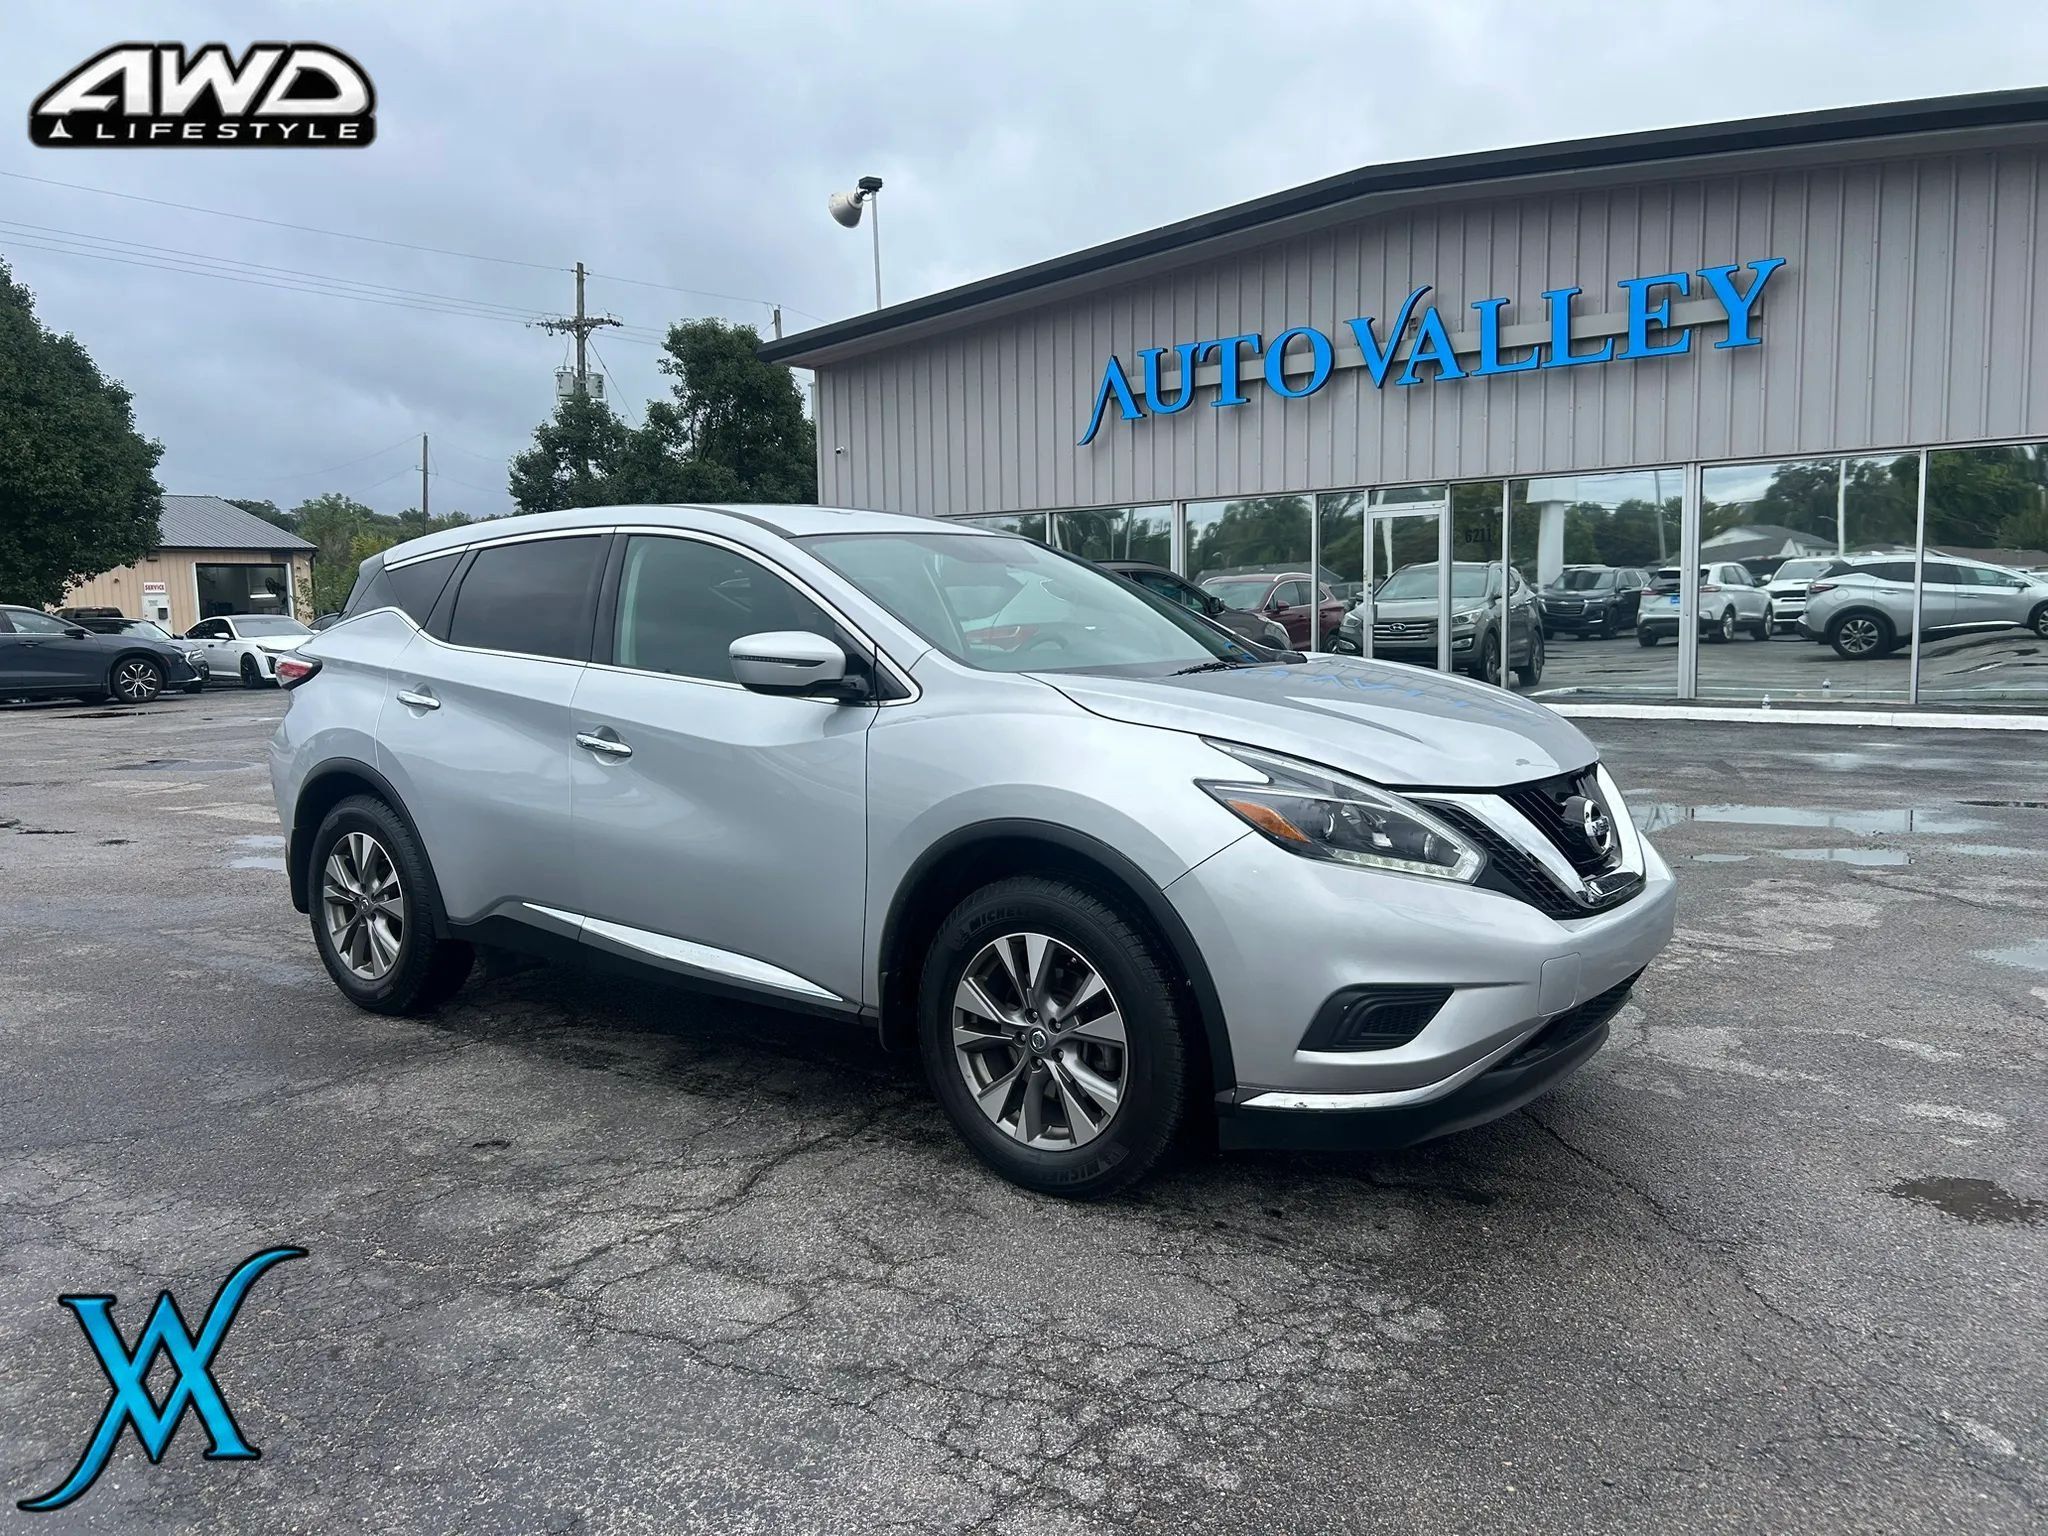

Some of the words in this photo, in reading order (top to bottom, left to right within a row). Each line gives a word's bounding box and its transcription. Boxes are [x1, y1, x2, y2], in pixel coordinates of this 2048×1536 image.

[1077, 326, 1334, 447] AUTO
[1344, 256, 1786, 389] VALLEY
[1465, 527, 1492, 544] 6211
[969, 905, 1029, 932] MICHEL
